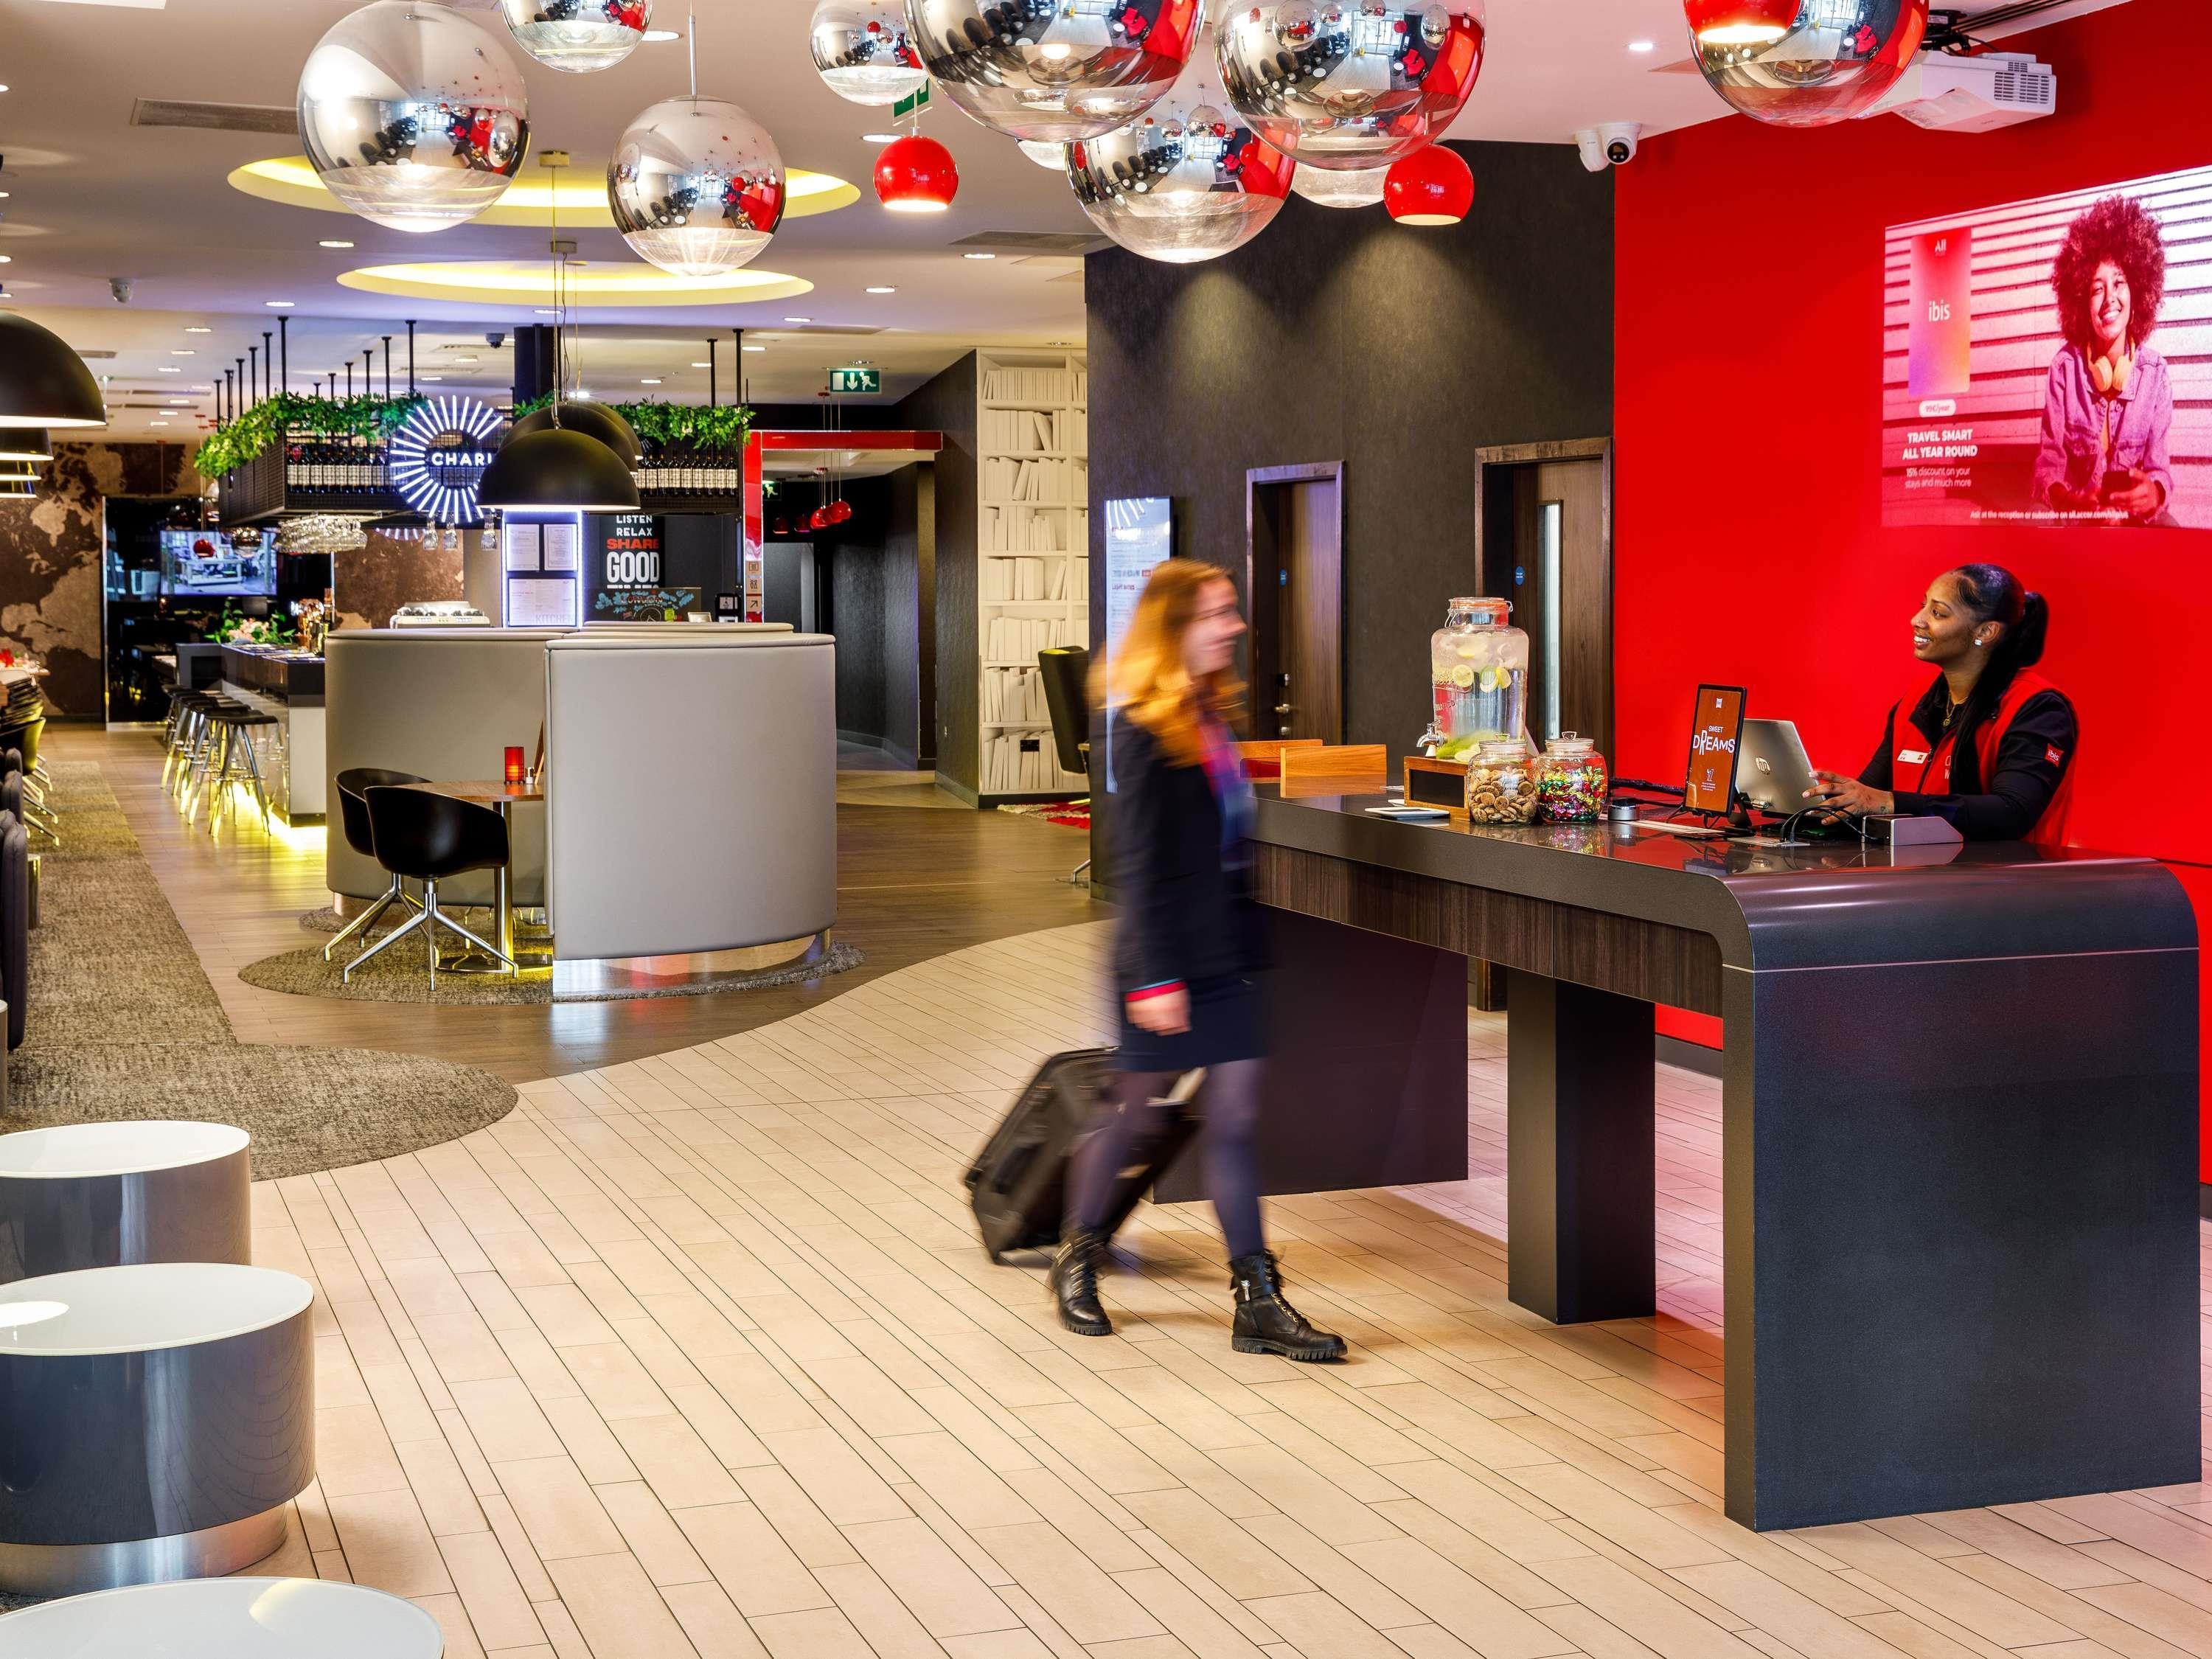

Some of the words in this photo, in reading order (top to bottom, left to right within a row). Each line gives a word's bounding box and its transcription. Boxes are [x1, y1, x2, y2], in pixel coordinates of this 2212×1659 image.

[1928, 299, 1950, 322] ibis
[1907, 430, 1940, 444] TRAVEL
[1941, 428, 1973, 442] SMART
[1902, 448, 1919, 460] ALL
[1920, 446, 1944, 459] YEAR
[1945, 445, 1978, 457] ROUND
[1919, 467, 1946, 476] discount
[1947, 468, 1955, 476] on
[1955, 468, 1970, 478] your
[1921, 477, 1934, 487] and
[1935, 478, 1953, 487] much
[1954, 479, 1972, 487] more
[616, 515, 653, 524] LISTEN
[1988, 510, 1997, 519] the
[616, 527, 653, 537] RELAX
[607, 538, 659, 549] SHARE
[606, 552, 660, 583] GOOD
[1693, 730, 1735, 755] DREAMS
[2048, 749, 2059, 761] ibis
